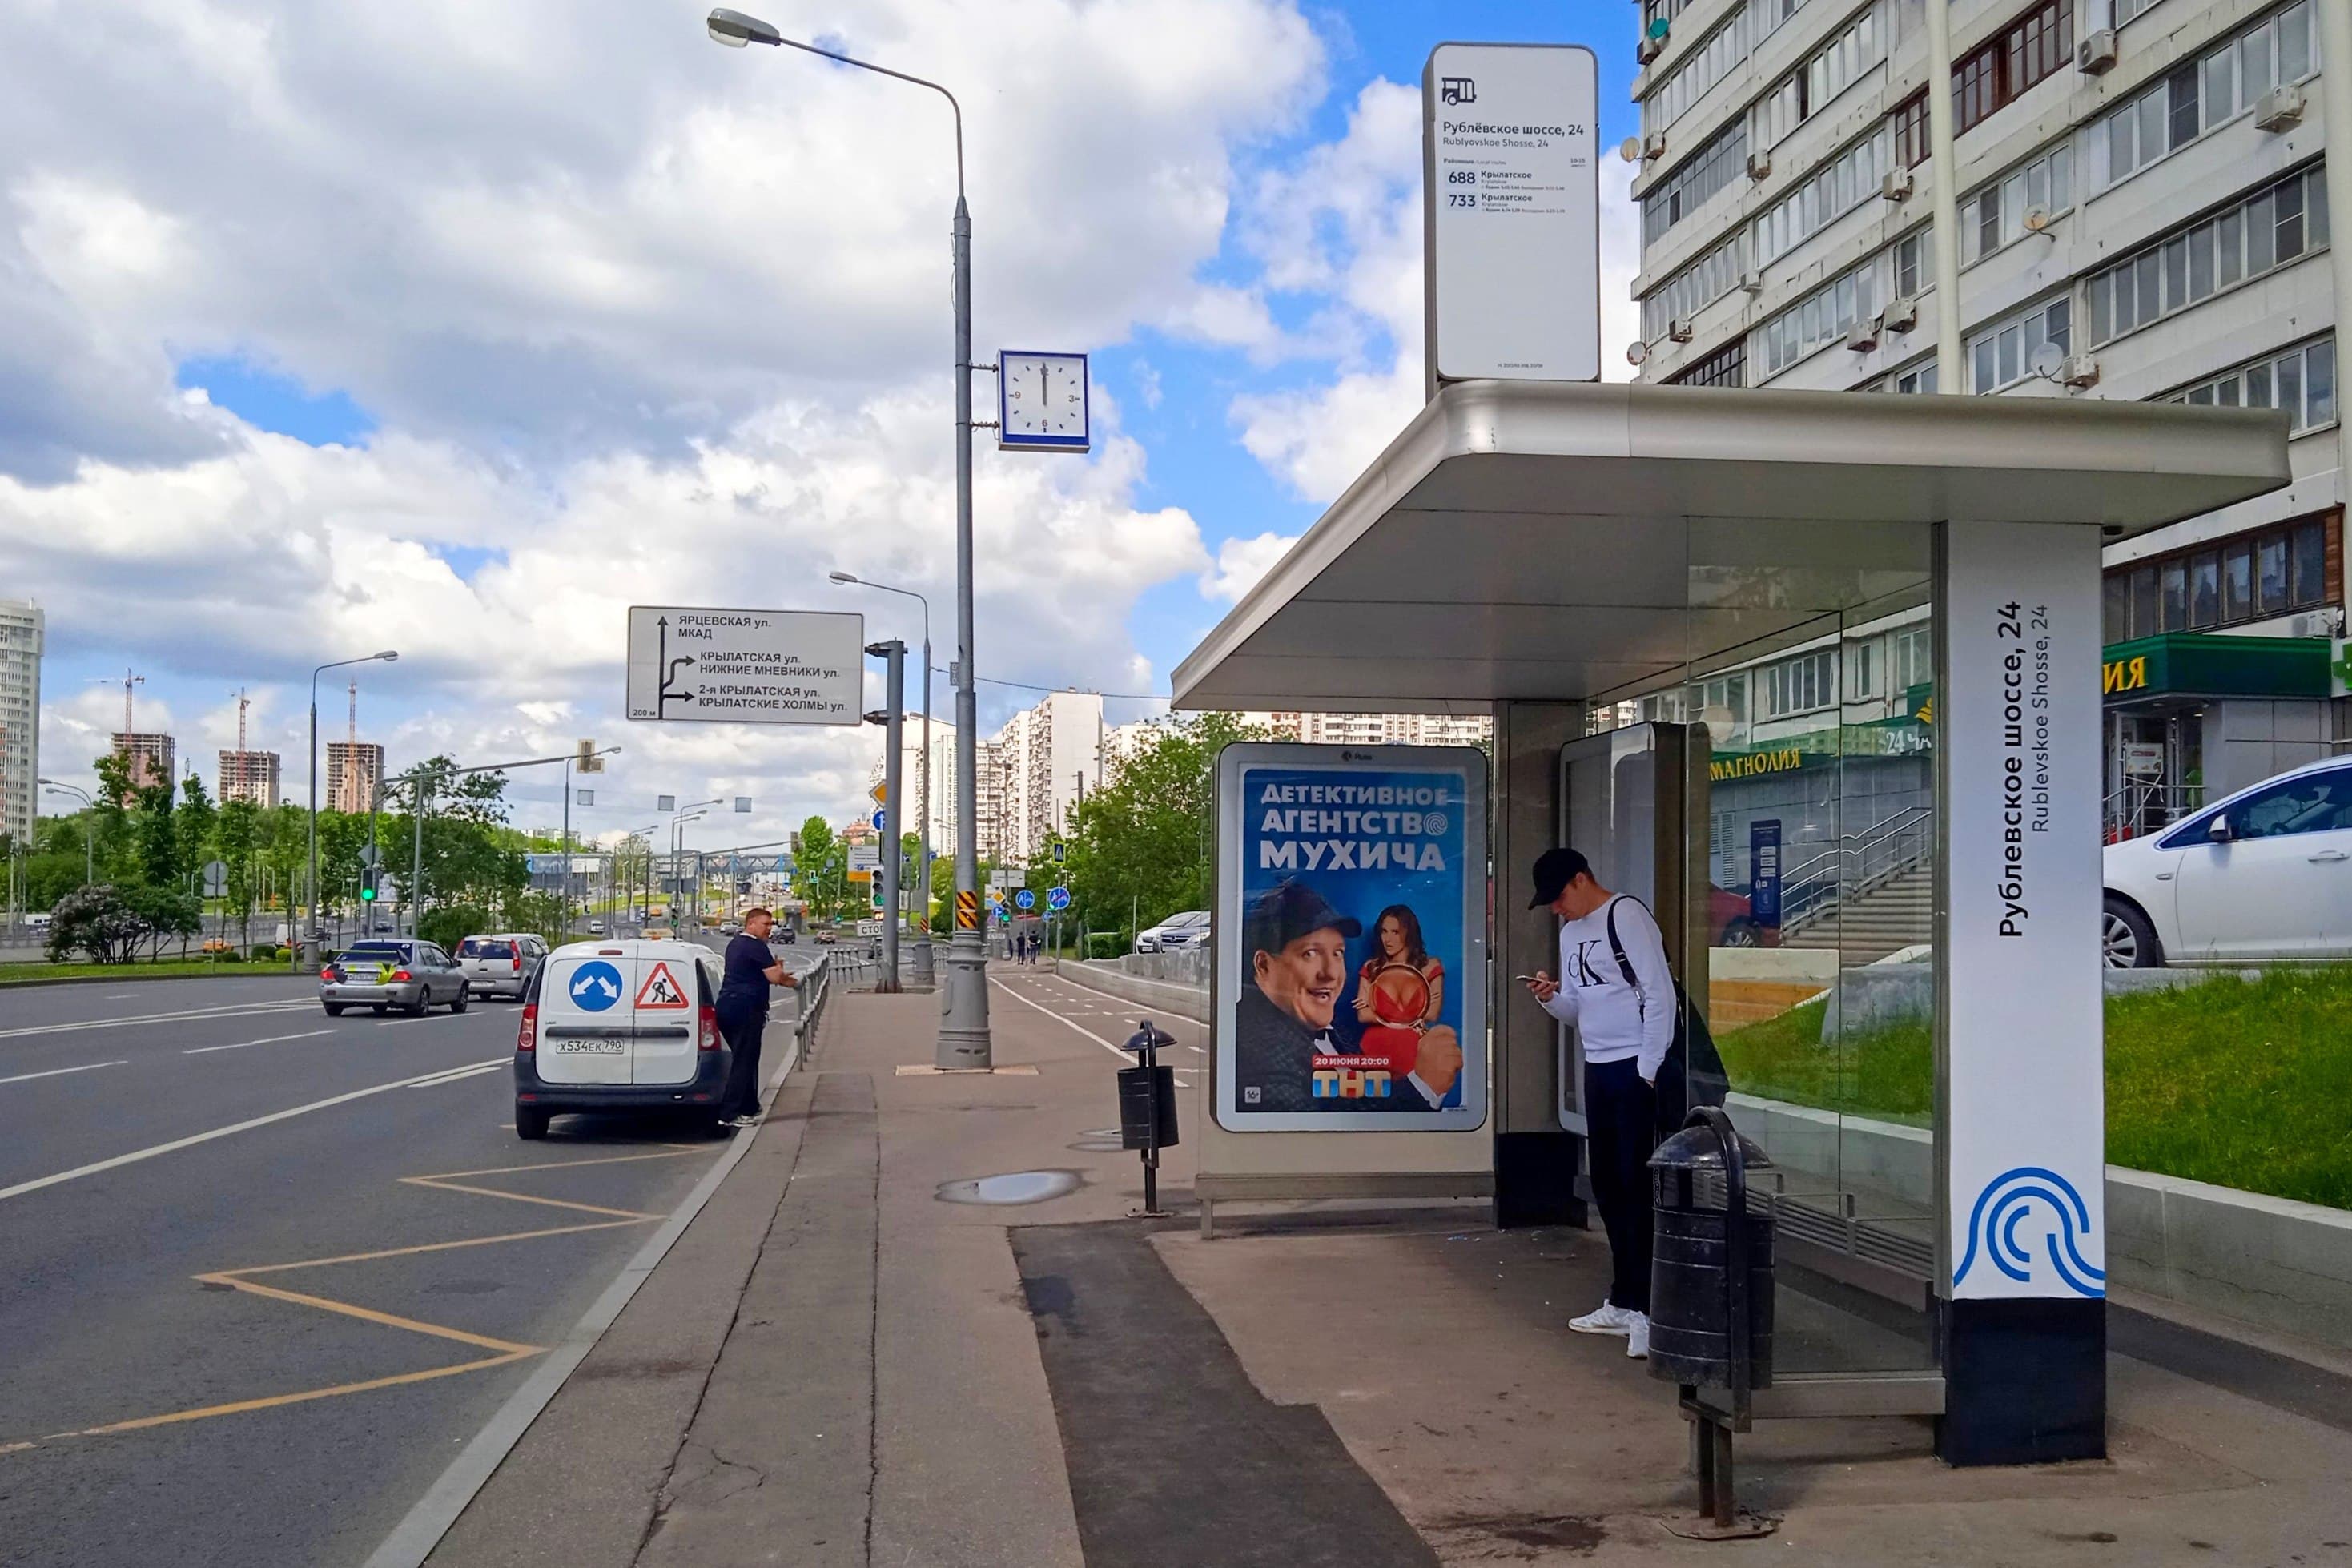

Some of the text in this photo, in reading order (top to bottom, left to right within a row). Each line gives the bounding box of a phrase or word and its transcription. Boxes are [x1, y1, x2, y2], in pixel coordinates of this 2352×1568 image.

[1443, 121, 1584, 137] Рублёвское шоссе, 24
[1443, 137, 1549, 149] Rublyovskoe Shosse, 24
[1449, 171, 1476, 184] 688
[1481, 170, 1532, 179] Крылатское
[1449, 195, 1476, 207] 733
[1482, 193, 1533, 203] Крылатское
[1015, 391, 1021, 399] 9
[1068, 395, 1075, 403] 3
[1042, 419, 1048, 427] 6
[678, 615, 771, 628] ЯРЦЕВСКАЯ ул.
[678, 628, 712, 639] МКАД
[700, 651, 801, 665] КРЫЛАТСКАЯ ул.
[700, 664, 840, 678] НИЖНИЕ МНЕВНИКИ ул.
[699, 685, 821, 698] 2-я КРЫЛАТСКАЯ ул.
[699, 698, 848, 712] КРЫЛАТСКИЕ ХОЛМЫ ул.
[633, 709, 647, 718] 200
[2032, 604, 2051, 833] Rublevskoe Shosse, 24
[1886, 730, 1905, 754] 24
[1709, 747, 1803, 782] МАГНОЛИЯ
[1997, 601, 2028, 937] Рублевское шоссе, 24
[1260, 783, 1449, 806] ДЕТЕКТИВНОЕ
[1260, 839, 1446, 872] МУХИЧА
[1315, 1057, 1389, 1066] 20 ИЮНЯ 20:00
[1313, 1070, 1392, 1098] ТНТ
